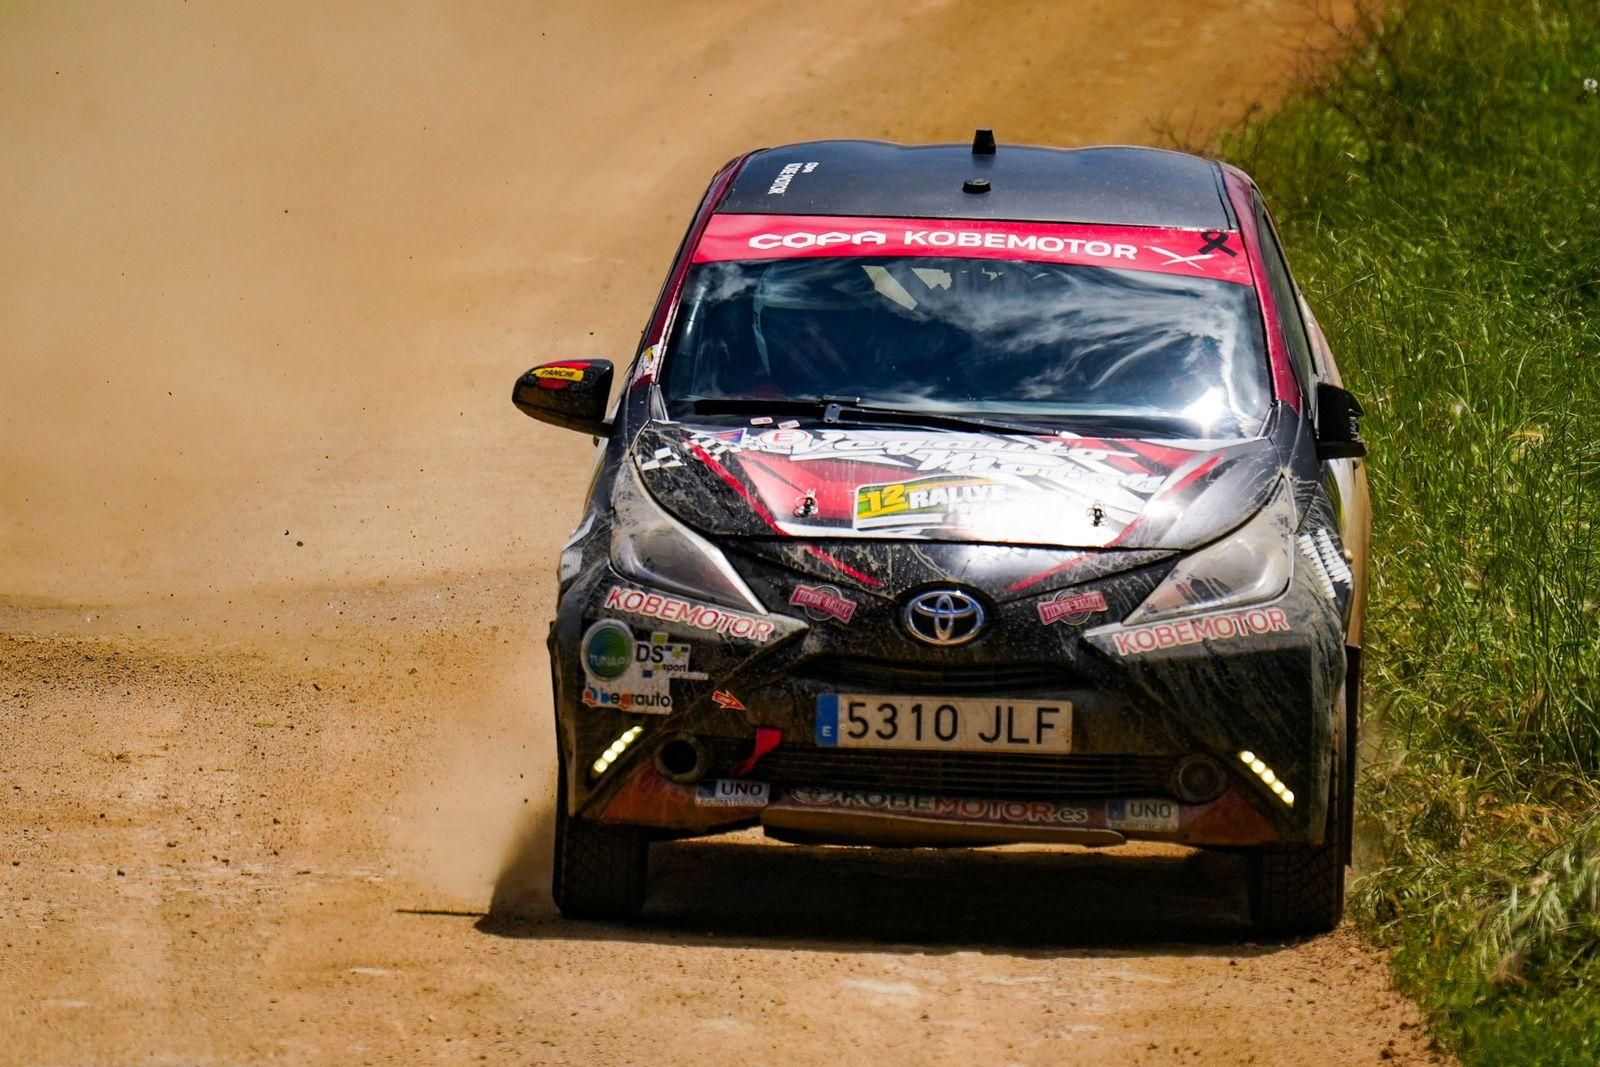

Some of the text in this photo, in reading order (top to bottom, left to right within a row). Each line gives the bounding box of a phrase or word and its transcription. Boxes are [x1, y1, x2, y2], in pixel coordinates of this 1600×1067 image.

[749, 230, 1138, 260] COPA KOBEMOTOR
[540, 369, 575, 377] PANCHI
[867, 484, 1006, 513] 12 RALLYE
[604, 586, 774, 641] KOBEMOTOR
[1113, 609, 1291, 655] KOBEMOTOR
[636, 643, 664, 663] DS
[662, 663, 687, 673] sport
[821, 725, 833, 738] E
[846, 702, 1061, 745] 5310 JLF
[721, 782, 763, 797] UNO
[1130, 802, 1172, 819] UNO
